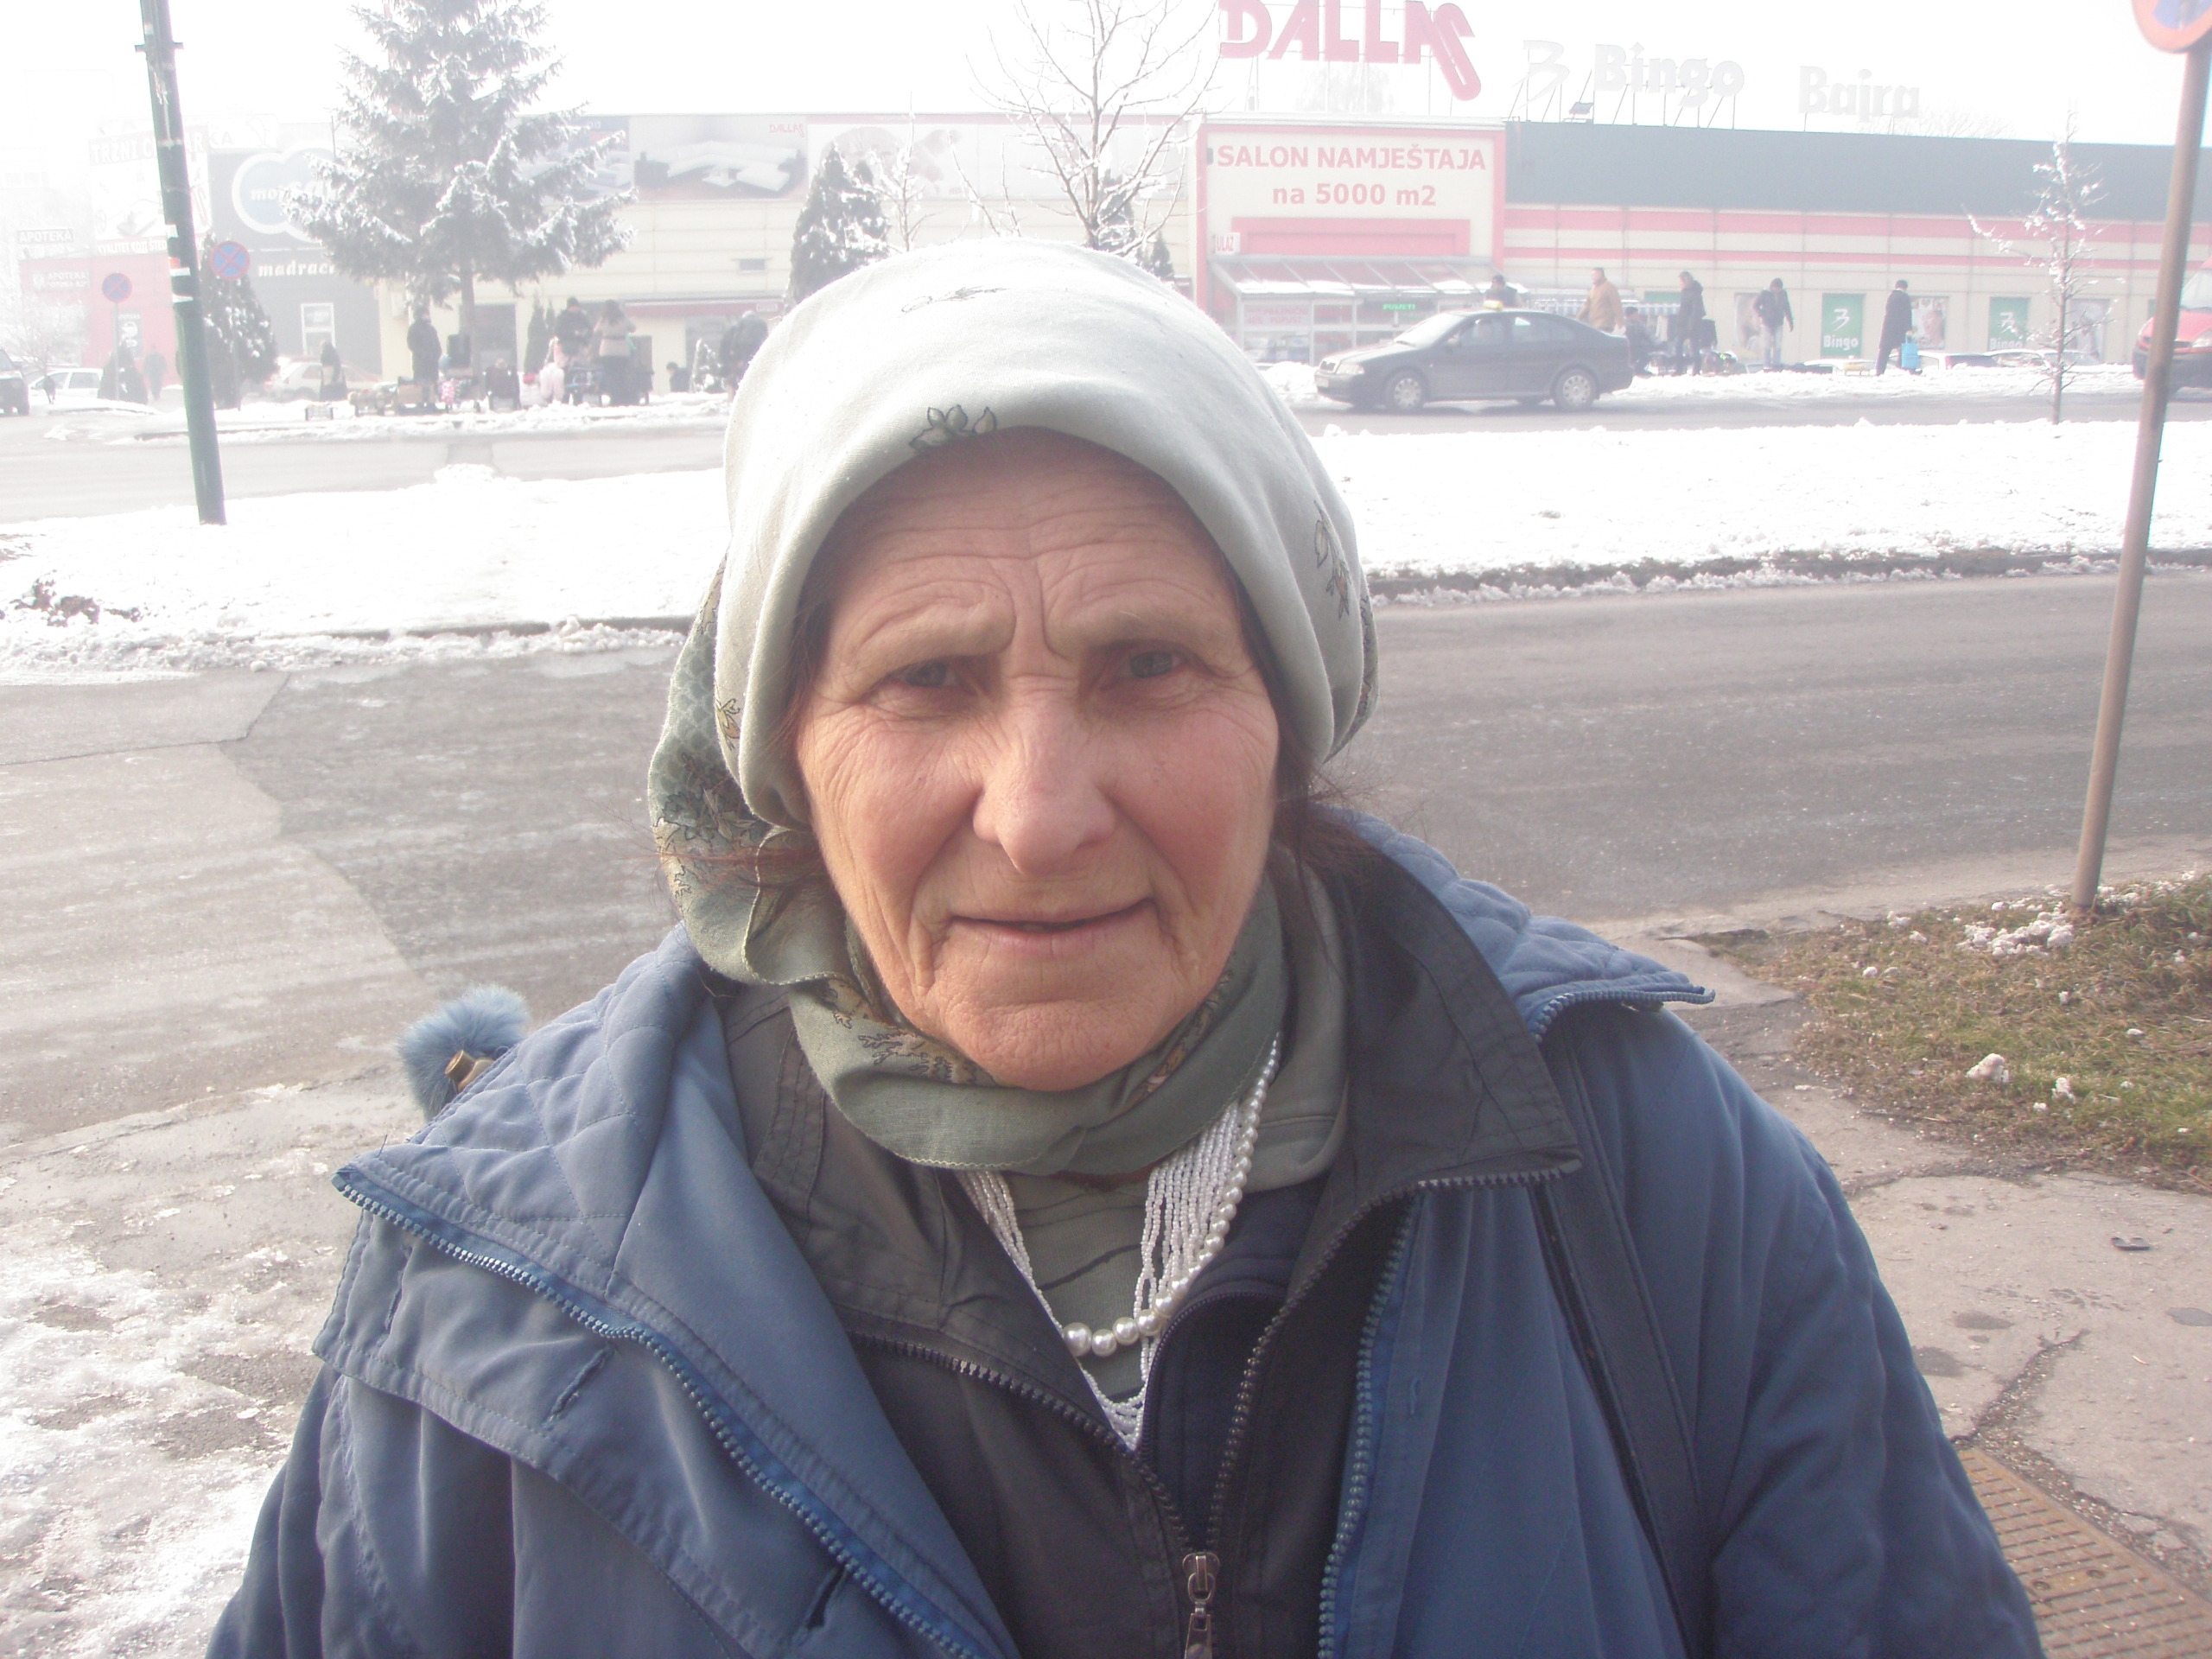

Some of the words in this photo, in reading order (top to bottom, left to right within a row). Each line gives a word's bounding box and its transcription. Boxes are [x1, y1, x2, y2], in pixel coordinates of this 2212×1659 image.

[1219, 0, 1482, 101] DALLAS
[1594, 41, 1745, 107] Bingo
[1797, 65, 1920, 123] Bajra
[768, 123, 805, 137] DALLAS
[91, 135, 137, 164] TRŽNI
[143, 131, 204, 158] CAR
[1217, 145, 1309, 168] SALON
[1317, 143, 1486, 170] NAMJEŠTAJA
[1273, 186, 1305, 205] na
[1315, 182, 1386, 206] 5000
[1395, 185, 1437, 207] m2
[19, 229, 73, 243] APOTEKA
[1217, 235, 1235, 252] ULAZ
[1823, 334, 1859, 351] Bingo
